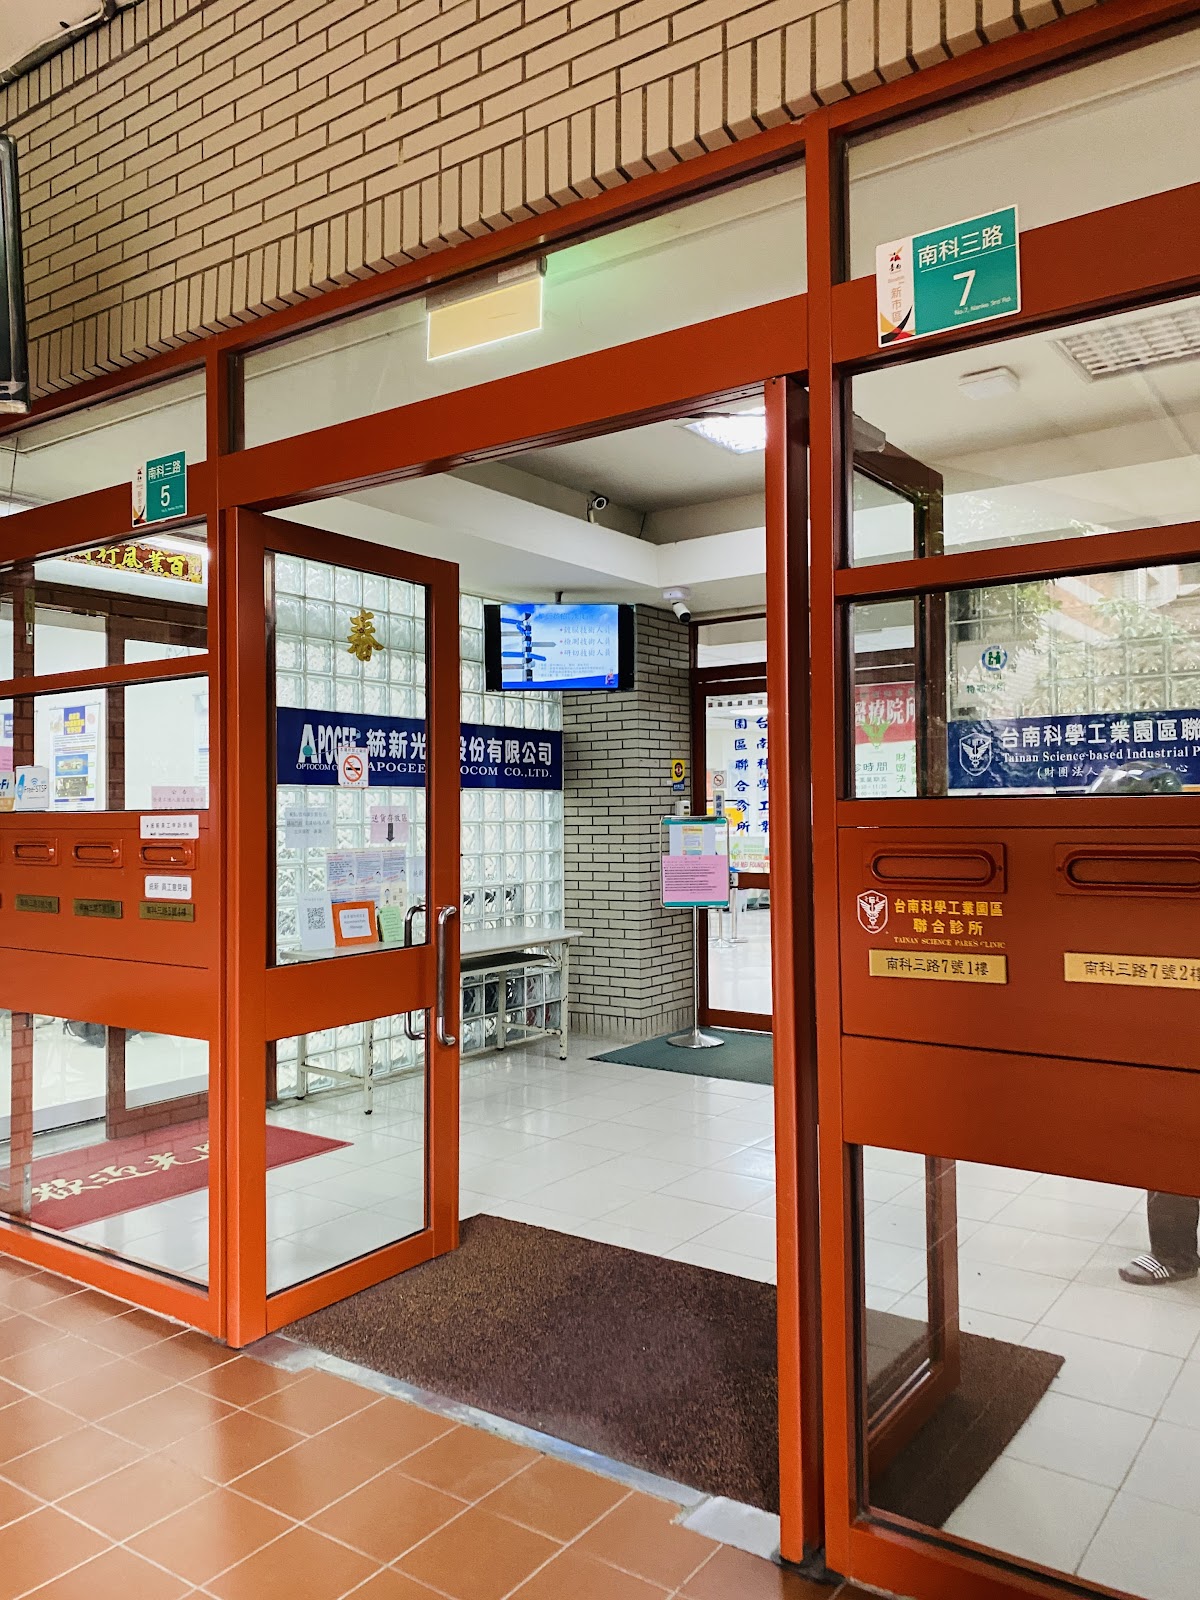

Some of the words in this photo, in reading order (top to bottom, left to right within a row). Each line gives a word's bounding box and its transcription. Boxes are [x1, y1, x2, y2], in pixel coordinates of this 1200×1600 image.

[917, 224, 1003, 269] 南科三路
[953, 270, 976, 307] 7
[148, 460, 181, 480] 南科三路
[160, 484, 171, 507] 5
[1000, 717, 1200, 749] 台南科學工業園區聯
[1003, 752, 1039, 764] Tainan
[1042, 749, 1123, 762] Science-based
[1127, 746, 1188, 760] Industrial
[296, 763, 331, 771] OPTOCOM
[368, 762, 426, 774] APOGEE
[894, 898, 1004, 917] 台南科學工業園區
[913, 918, 984, 936] 聯合診所
[894, 936, 919, 945] TAINAN
[921, 938, 952, 947] SCIENCE
[886, 956, 990, 977] 南科三路7號1樓
